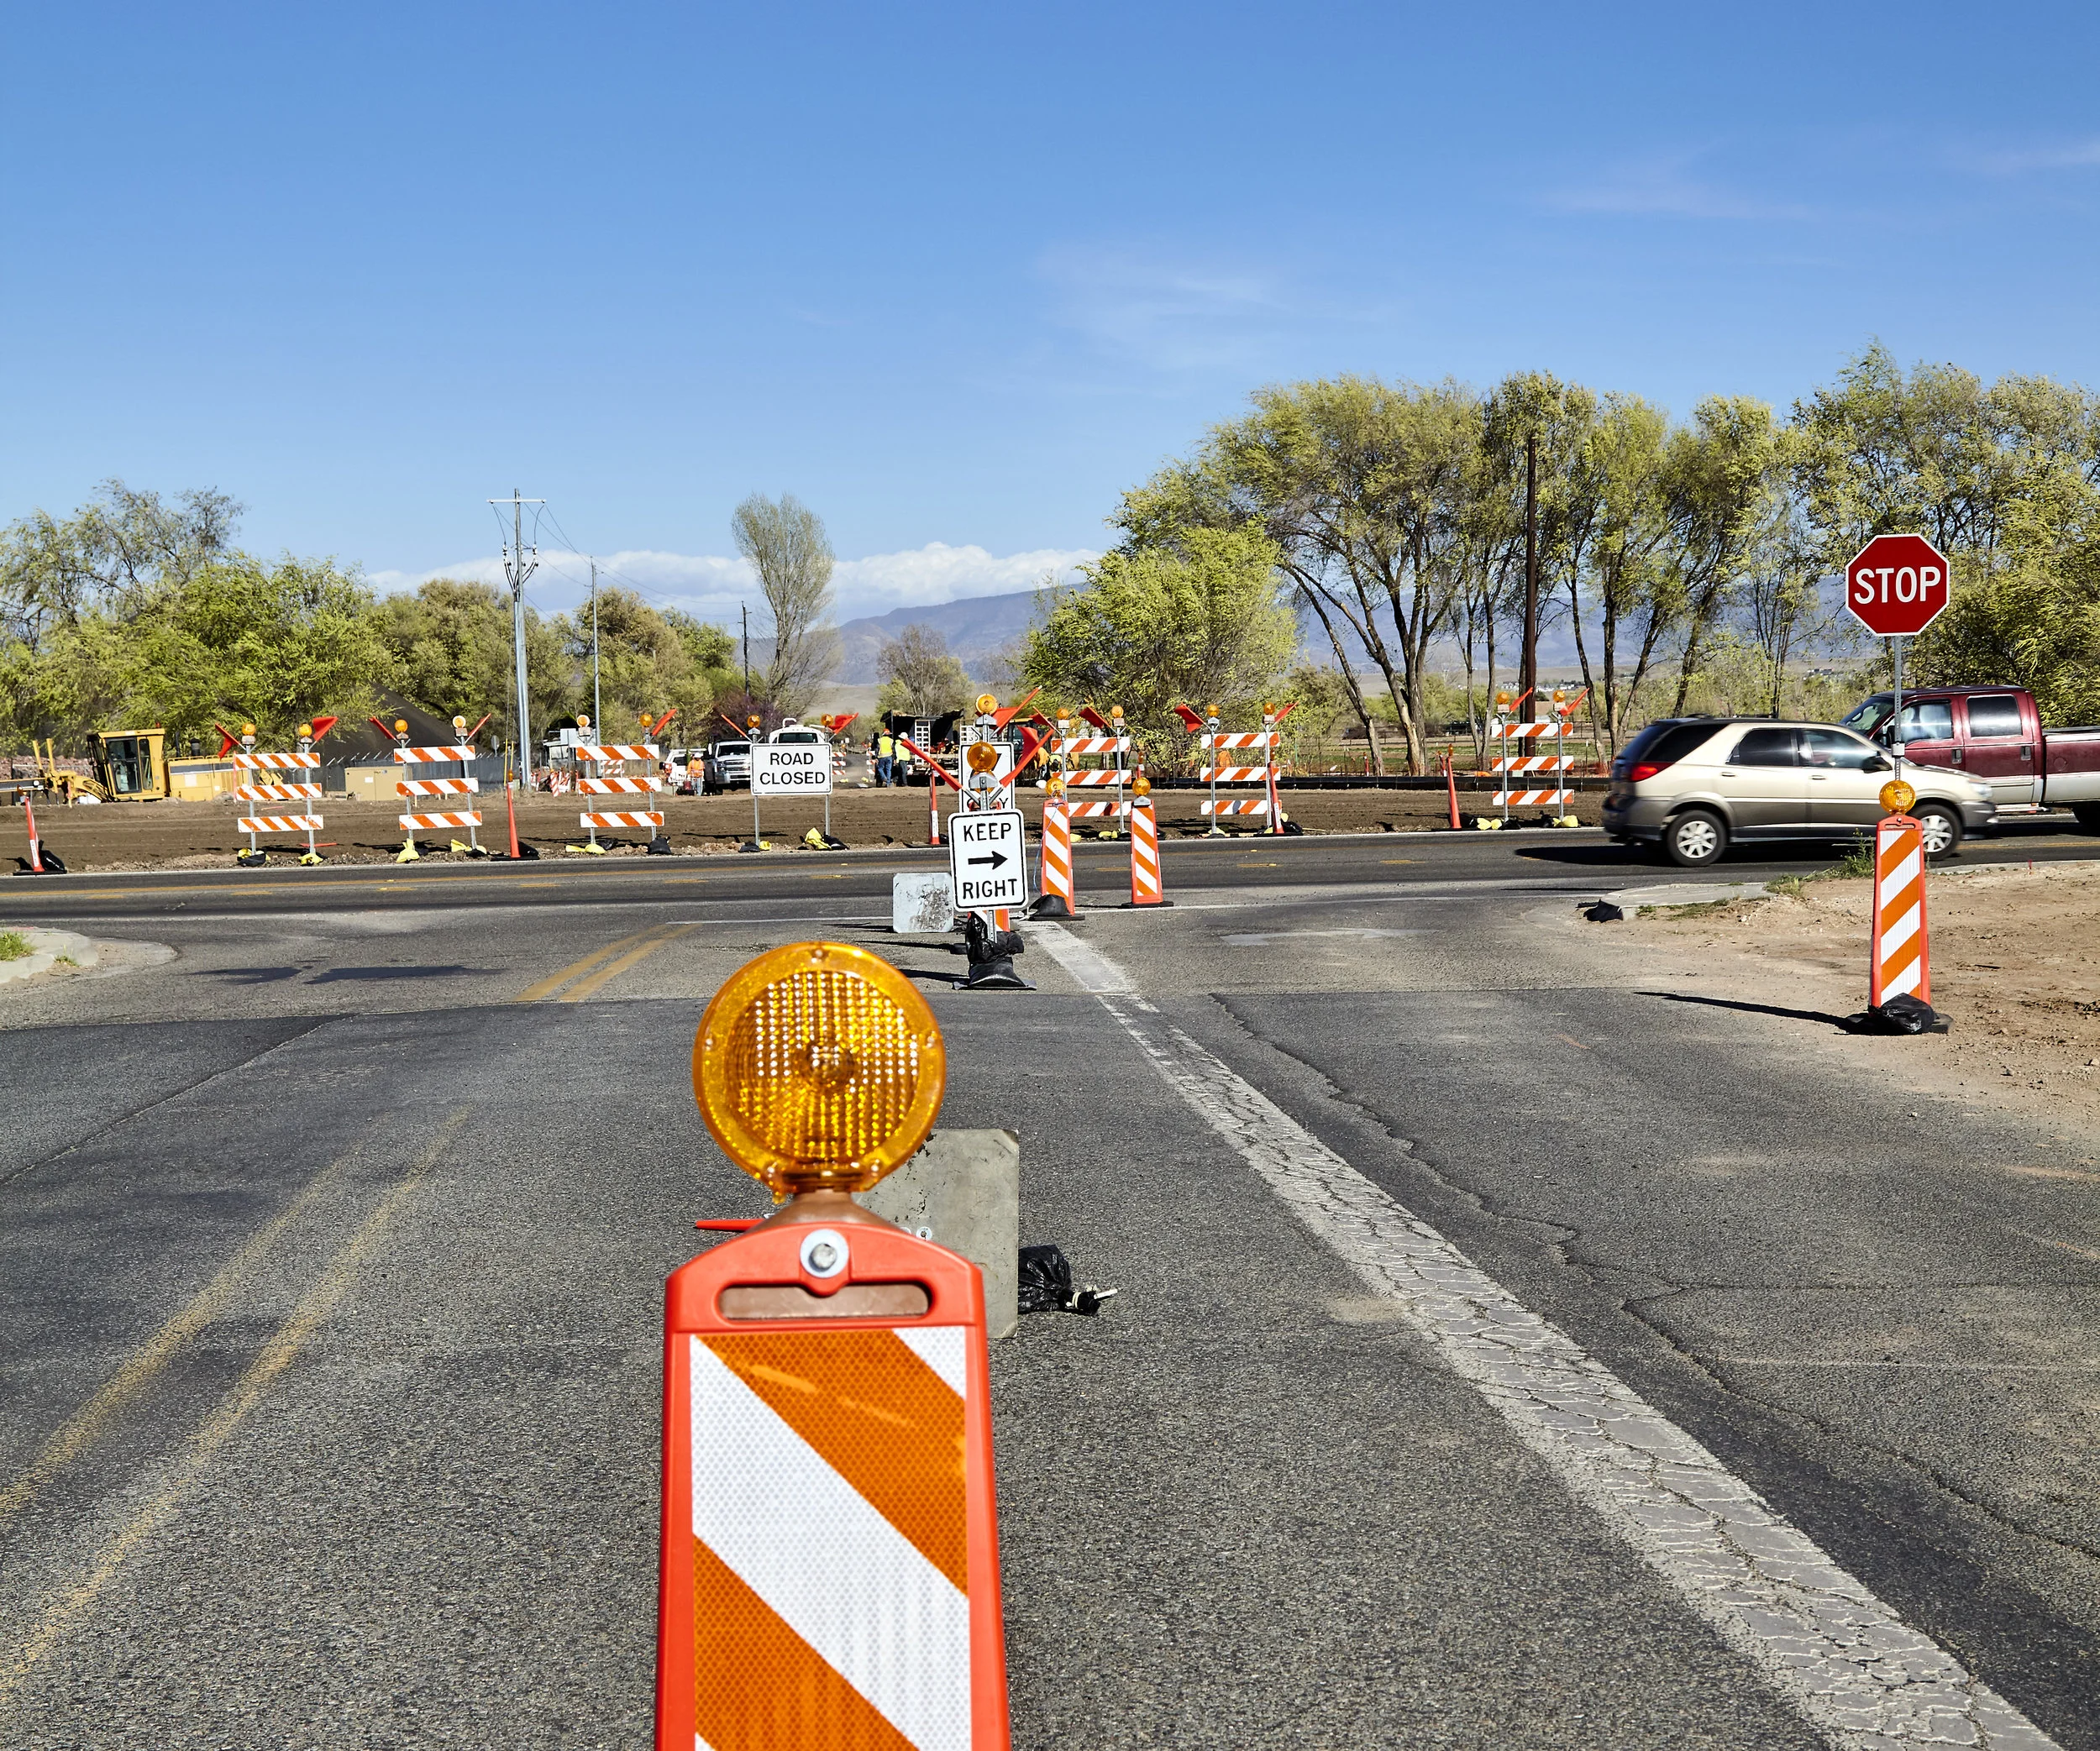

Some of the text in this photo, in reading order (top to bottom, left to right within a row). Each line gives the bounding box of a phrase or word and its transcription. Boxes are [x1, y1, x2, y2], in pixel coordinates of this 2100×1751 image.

[1854, 566, 1941, 605] STOP
[769, 752, 814, 766] ROAD
[759, 772, 826, 785] CLOSED
[963, 823, 1011, 841] KEEP
[963, 878, 1017, 899] RIGHT
